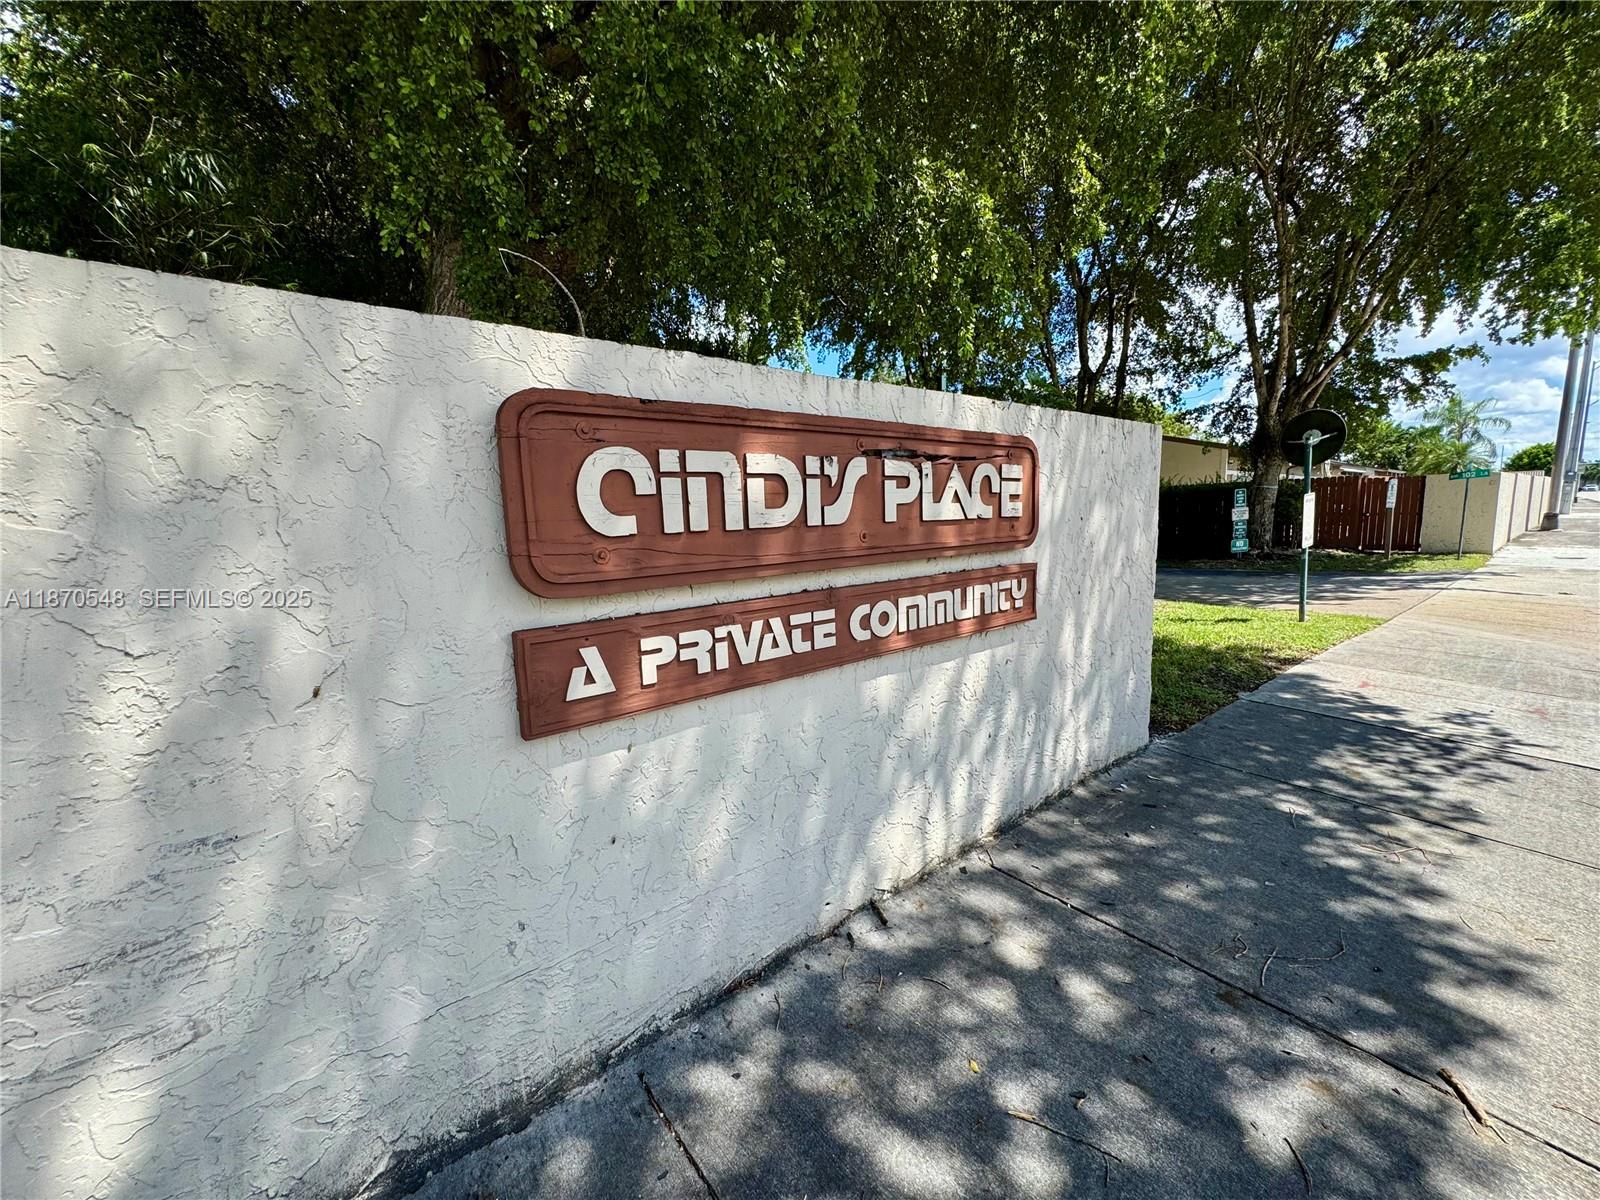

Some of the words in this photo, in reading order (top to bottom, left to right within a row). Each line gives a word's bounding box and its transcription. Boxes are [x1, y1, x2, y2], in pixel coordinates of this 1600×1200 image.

[576, 446, 867, 537] CINDI'S
[884, 458, 1023, 523] PLACE
[565, 646, 617, 702] A
[640, 608, 837, 686] PRIVATE
[849, 577, 1028, 642] COMMUNITY
